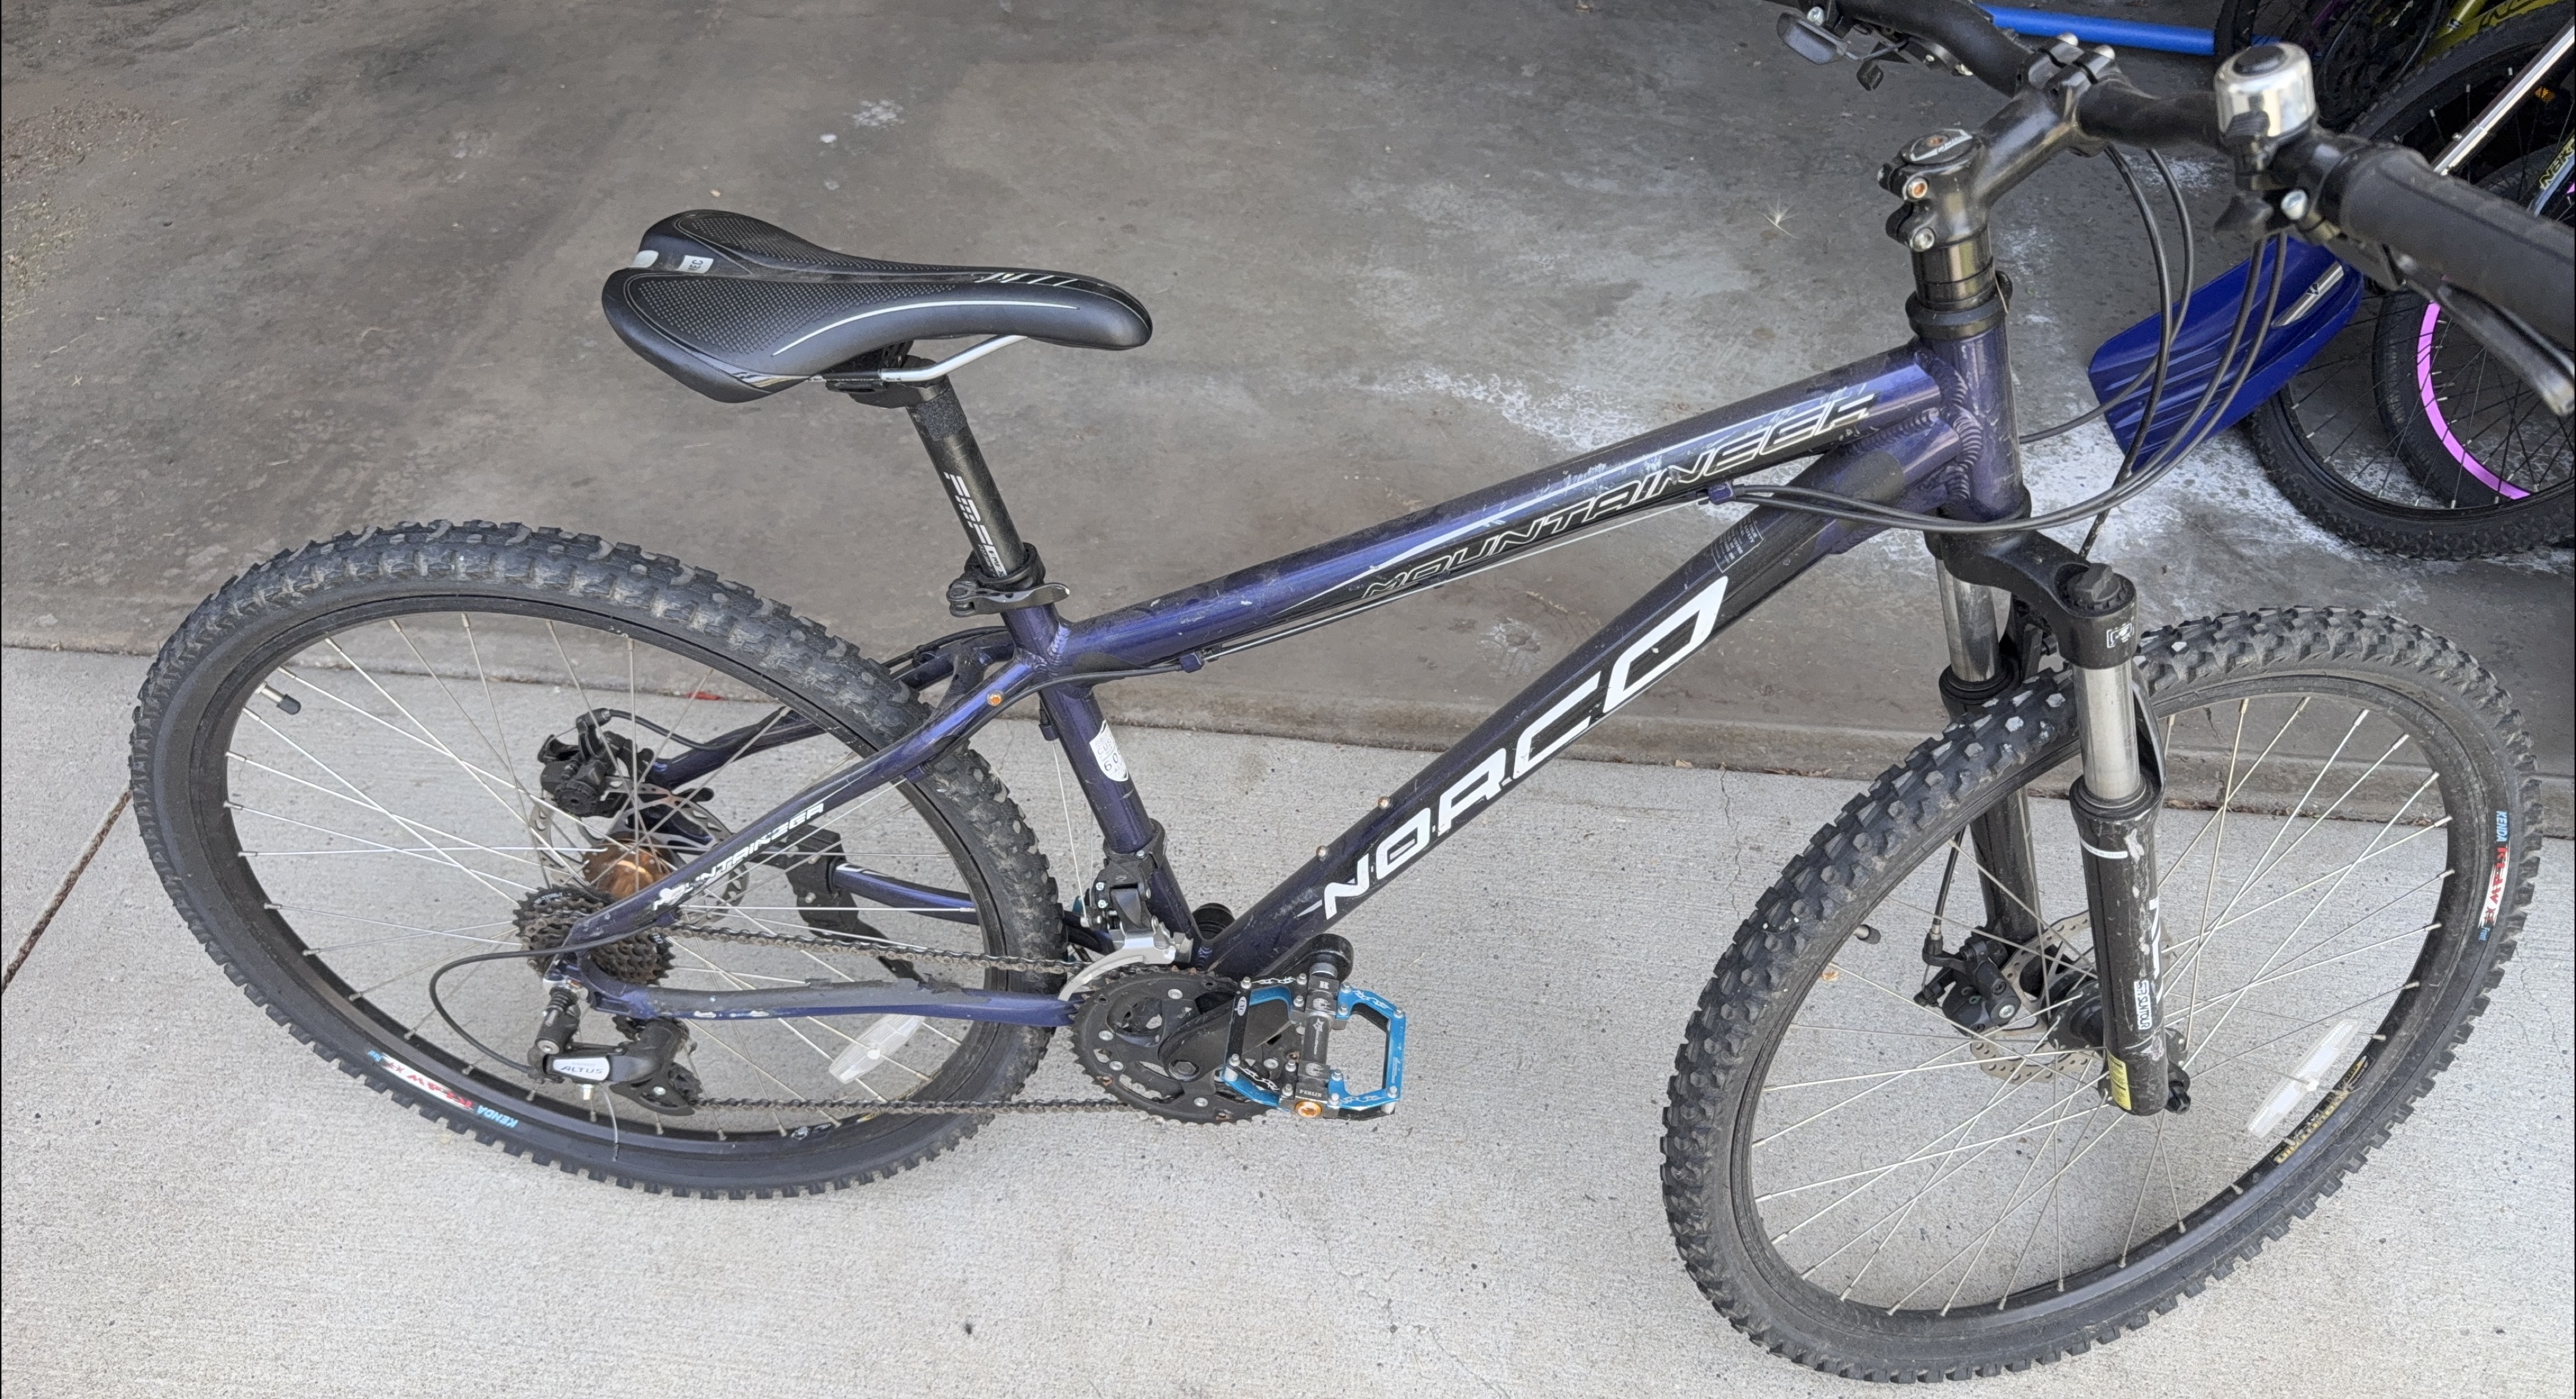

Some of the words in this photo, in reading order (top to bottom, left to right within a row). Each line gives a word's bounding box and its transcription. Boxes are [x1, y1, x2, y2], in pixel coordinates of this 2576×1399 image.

[1362, 394, 1879, 598] MOUNTAINEER
[1324, 575, 1729, 920] NORCO
[2496, 810, 2507, 842] KENDA
[2490, 847, 2507, 905] KLAW
[2478, 927, 2490, 941] Front
[2137, 996, 2150, 1028] SUNTOUR
[561, 1065, 604, 1074] ALTUS
[477, 1104, 519, 1129] KENDA
